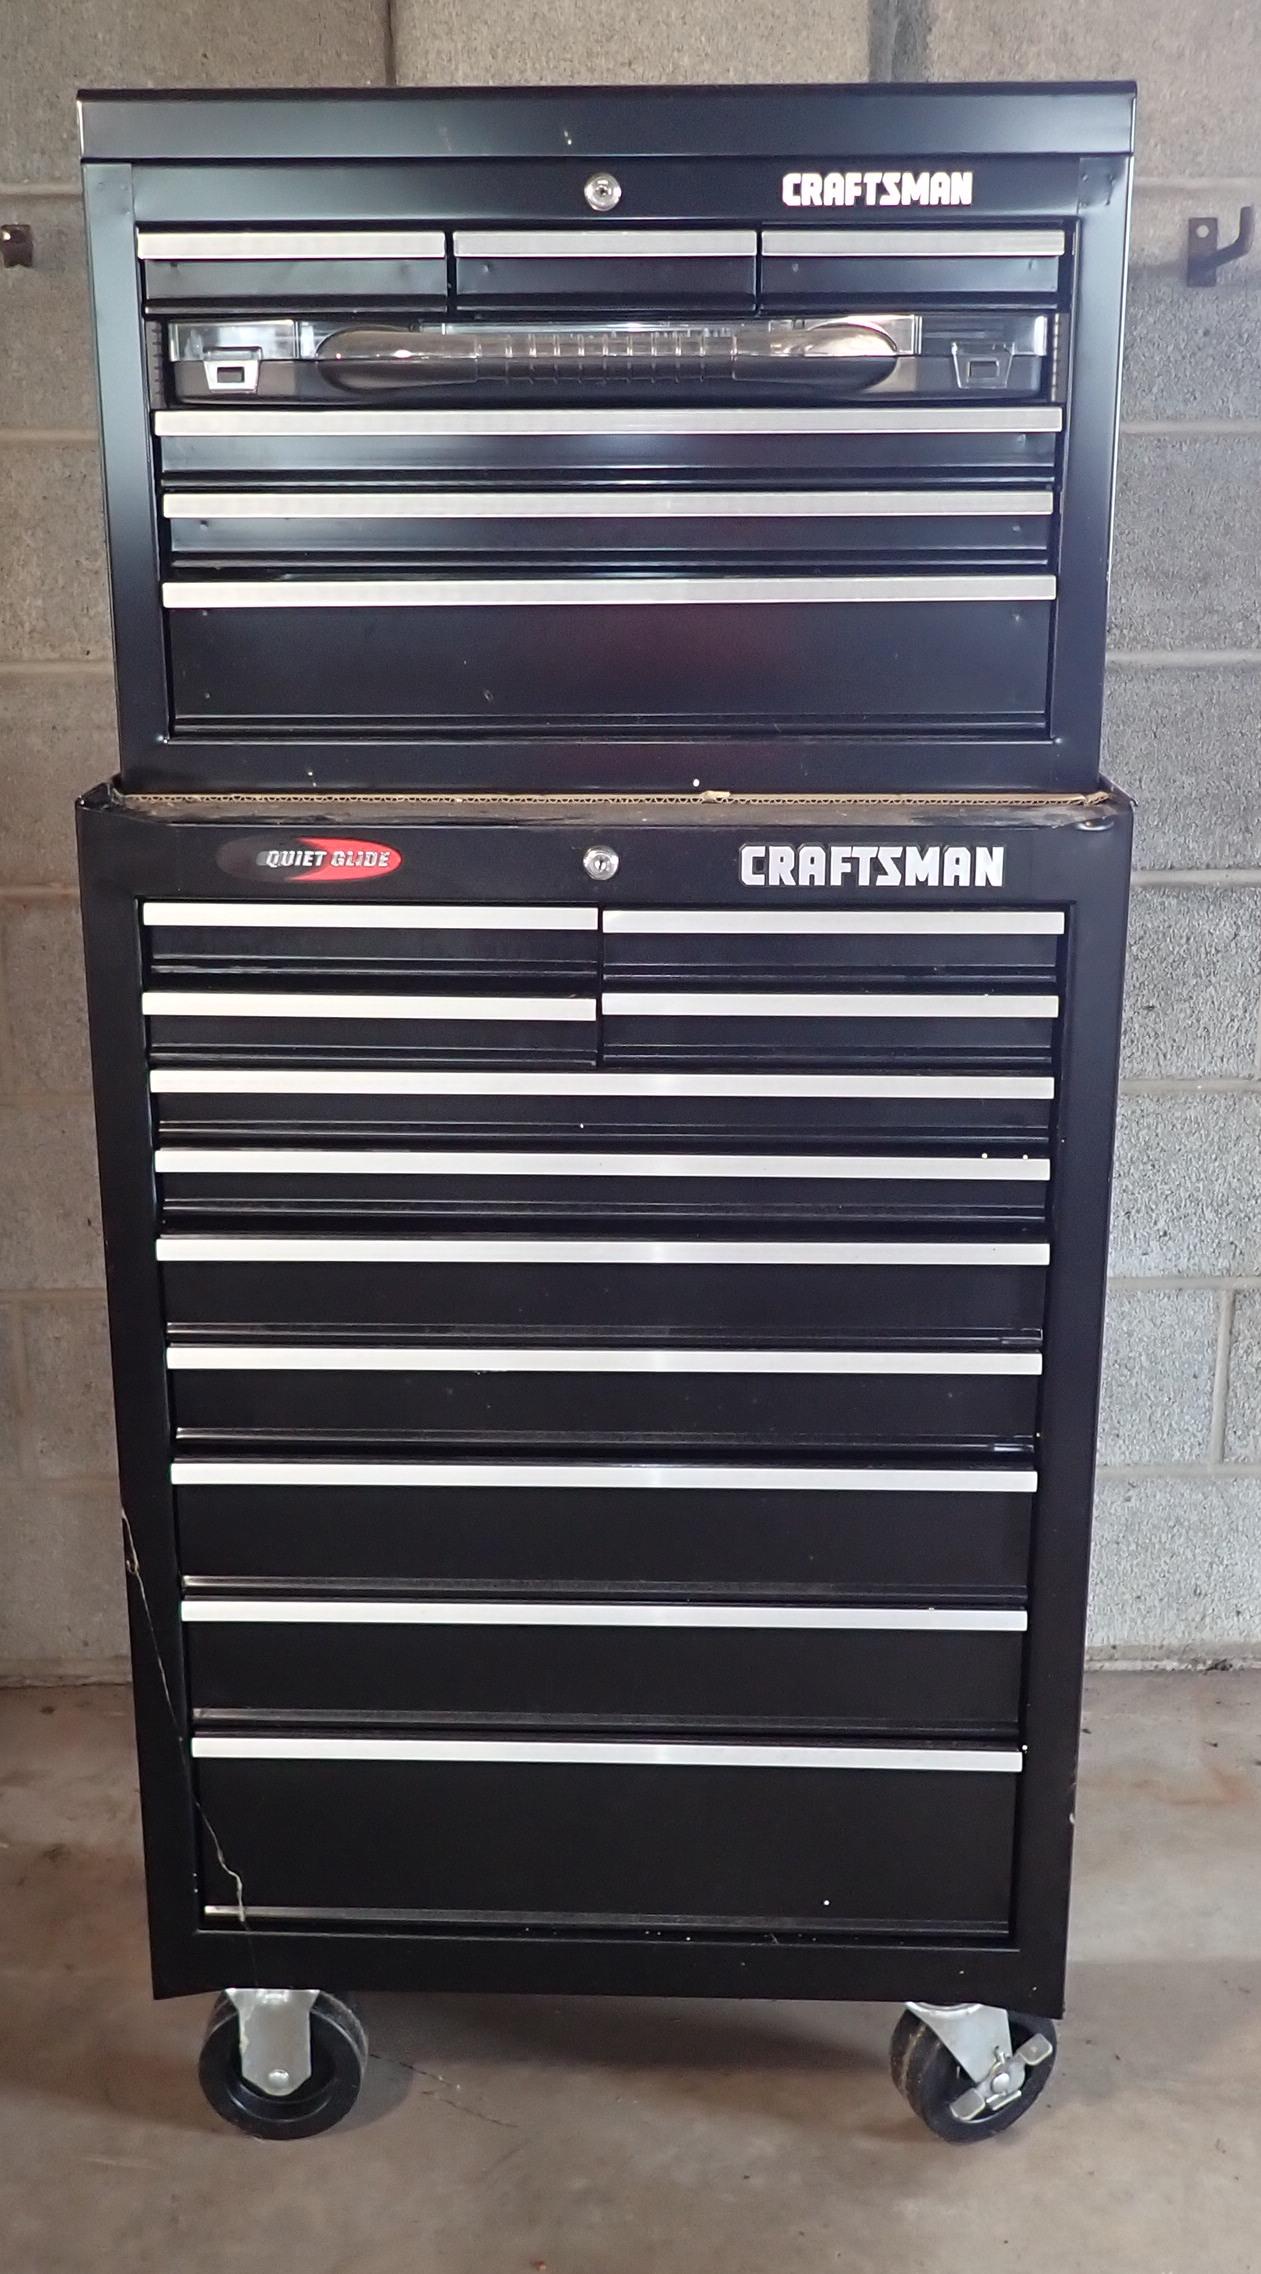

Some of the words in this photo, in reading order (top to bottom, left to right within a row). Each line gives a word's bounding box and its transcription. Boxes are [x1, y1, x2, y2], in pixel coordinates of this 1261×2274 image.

[782, 172, 974, 206] CRAFTSMAN
[265, 850, 327, 868] QUIET
[331, 851, 391, 868] GLIDE
[739, 844, 1005, 888] CRAFTSMAN
